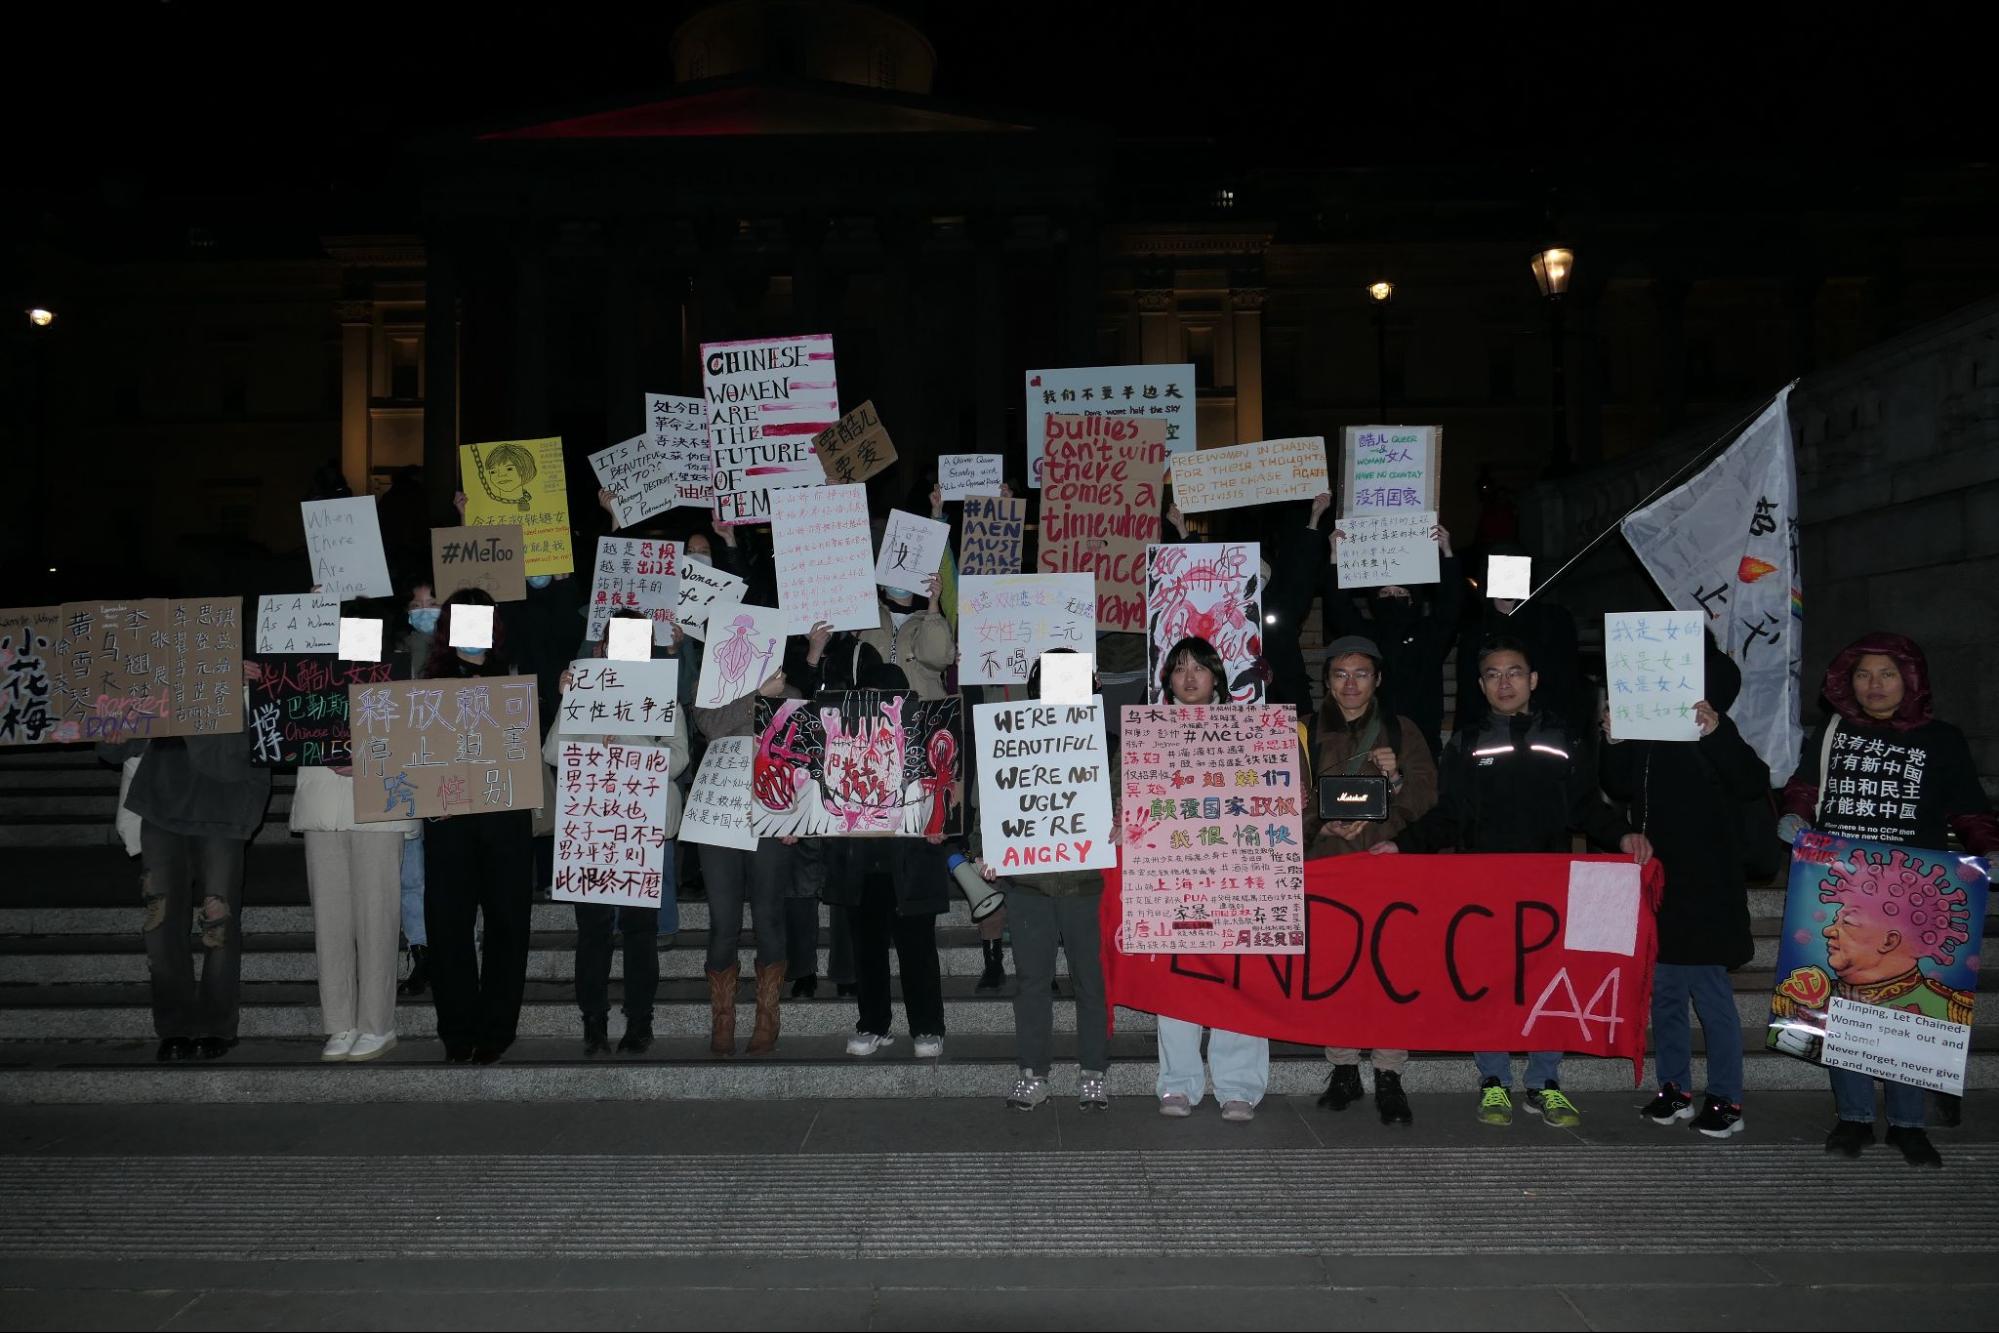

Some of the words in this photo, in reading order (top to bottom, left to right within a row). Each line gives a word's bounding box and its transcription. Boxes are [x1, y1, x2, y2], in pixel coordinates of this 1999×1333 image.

[707, 346, 809, 375] CHINESE
[707, 377, 790, 404] WOMEN
[1042, 384, 1183, 404] 我们不要半边天
[712, 406, 759, 426] ARE
[1046, 415, 1139, 441] bullies
[712, 425, 763, 444] THE
[819, 411, 877, 456] 要酷儿
[1358, 432, 1389, 448] 酷儿
[596, 448, 629, 471] IT'S
[637, 440, 647, 453] A
[713, 443, 809, 468] FUTURE
[1045, 438, 1112, 463] can't
[1120, 441, 1165, 464] win
[1385, 449, 1413, 464] 女人
[714, 469, 743, 490] OF
[1044, 457, 1128, 484] there
[608, 478, 629, 495] DAY
[1044, 483, 1124, 506] comes
[1135, 483, 1156, 508] a
[1356, 487, 1421, 507] 没有国家
[308, 508, 353, 529] When
[964, 499, 1021, 522] #ALL
[964, 521, 1021, 537] MEN
[441, 538, 514, 564] #MeToo
[603, 541, 676, 560] 越是恐惧
[964, 538, 1020, 557] MUST
[600, 559, 676, 576] 越要出门去
[291, 599, 302, 612] A
[595, 590, 640, 606] 黑夜里
[288, 618, 298, 630] A
[1611, 618, 1703, 642] 我是女的
[284, 637, 295, 651] A
[63, 612, 97, 723] 黄雪琴
[570, 666, 625, 692] 记住
[0, 628, 61, 741] 小花梅
[1613, 675, 1697, 694] 我是女人
[356, 682, 537, 735] 释放赖可
[564, 697, 677, 723] 女性抗争者
[994, 707, 1057, 733] WE'RE
[1066, 705, 1098, 724] NOT
[1125, 709, 1168, 724] 乌衣
[1178, 707, 1206, 721] 杀妻
[250, 702, 285, 762] 撑
[357, 724, 528, 779] 停止迫害
[564, 744, 668, 773] 告女界同胞
[993, 734, 1099, 759] BEAUTIFUL
[1832, 732, 1927, 767] 没有共产党
[995, 764, 1062, 790] WE'RE
[1068, 766, 1099, 784] NOT
[1170, 769, 1291, 789] 和姐妹们
[1829, 753, 1924, 785] 才有新中国
[384, 768, 514, 818] 跨性别
[1828, 777, 1921, 800] 自由和民主
[1019, 791, 1077, 812] UGLY
[1150, 796, 1299, 822] 颠覆国家政权
[1824, 796, 1918, 820] 才能救中国
[563, 821, 665, 848] 女子一日不与
[1001, 813, 1087, 838] WE'RE
[1170, 823, 1298, 850] 我很愉快
[1003, 840, 1092, 867] ANGRY
[556, 865, 661, 898] 此恨终不磨
[1153, 876, 1265, 891] 上海小红楼
[1275, 877, 1303, 890] 代孕
[1184, 893, 1207, 902] PUA
[1174, 904, 1211, 920] 家暴
[1253, 906, 1288, 924] 弃婴
[1133, 919, 1172, 938] 唐山
[1521, 966, 1624, 1044] A4
[1832, 998, 1843, 1009] Xi
[1847, 1002, 1889, 1020] Jinping,
[1893, 1011, 1911, 1023] Let
[1915, 1016, 1966, 1034] Chained-
[1830, 1013, 1873, 1031] Woman
[1878, 1023, 1911, 1041] speak
[1916, 1030, 1936, 1044] out
[1941, 1036, 1964, 1050] and
[1824, 1056, 1840, 1068] up
[1841, 1058, 1863, 1071] and
[1865, 1065, 1898, 1079] never
[1899, 1072, 1945, 1091] forgive!
[1826, 1043, 1860, 1058] Never
[1862, 1049, 1898, 1067] forget,
[1900, 1058, 1935, 1075] never
[1936, 1066, 1961, 1081] give
